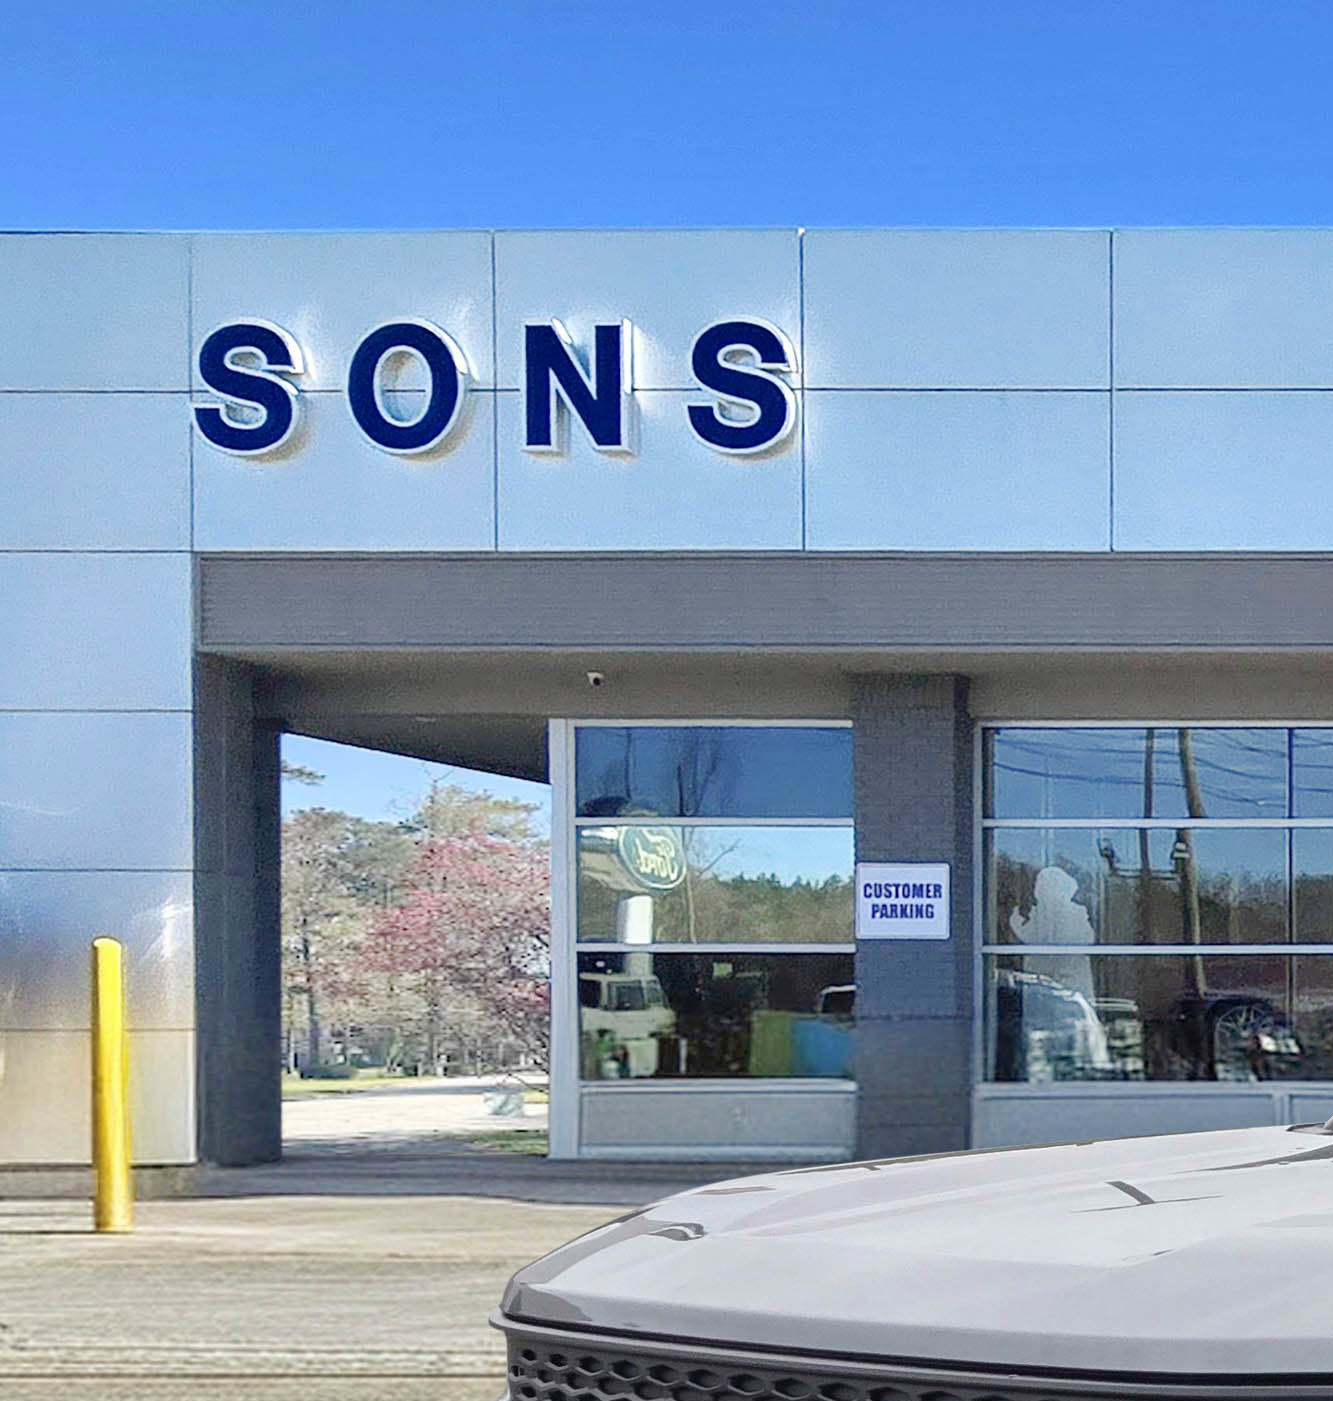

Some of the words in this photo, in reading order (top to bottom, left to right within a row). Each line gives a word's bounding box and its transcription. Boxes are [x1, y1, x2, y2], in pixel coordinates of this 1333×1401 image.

[194, 321, 796, 452] SONS
[863, 883, 942, 899] CUSTOMER
[871, 903, 935, 919] PARKING
